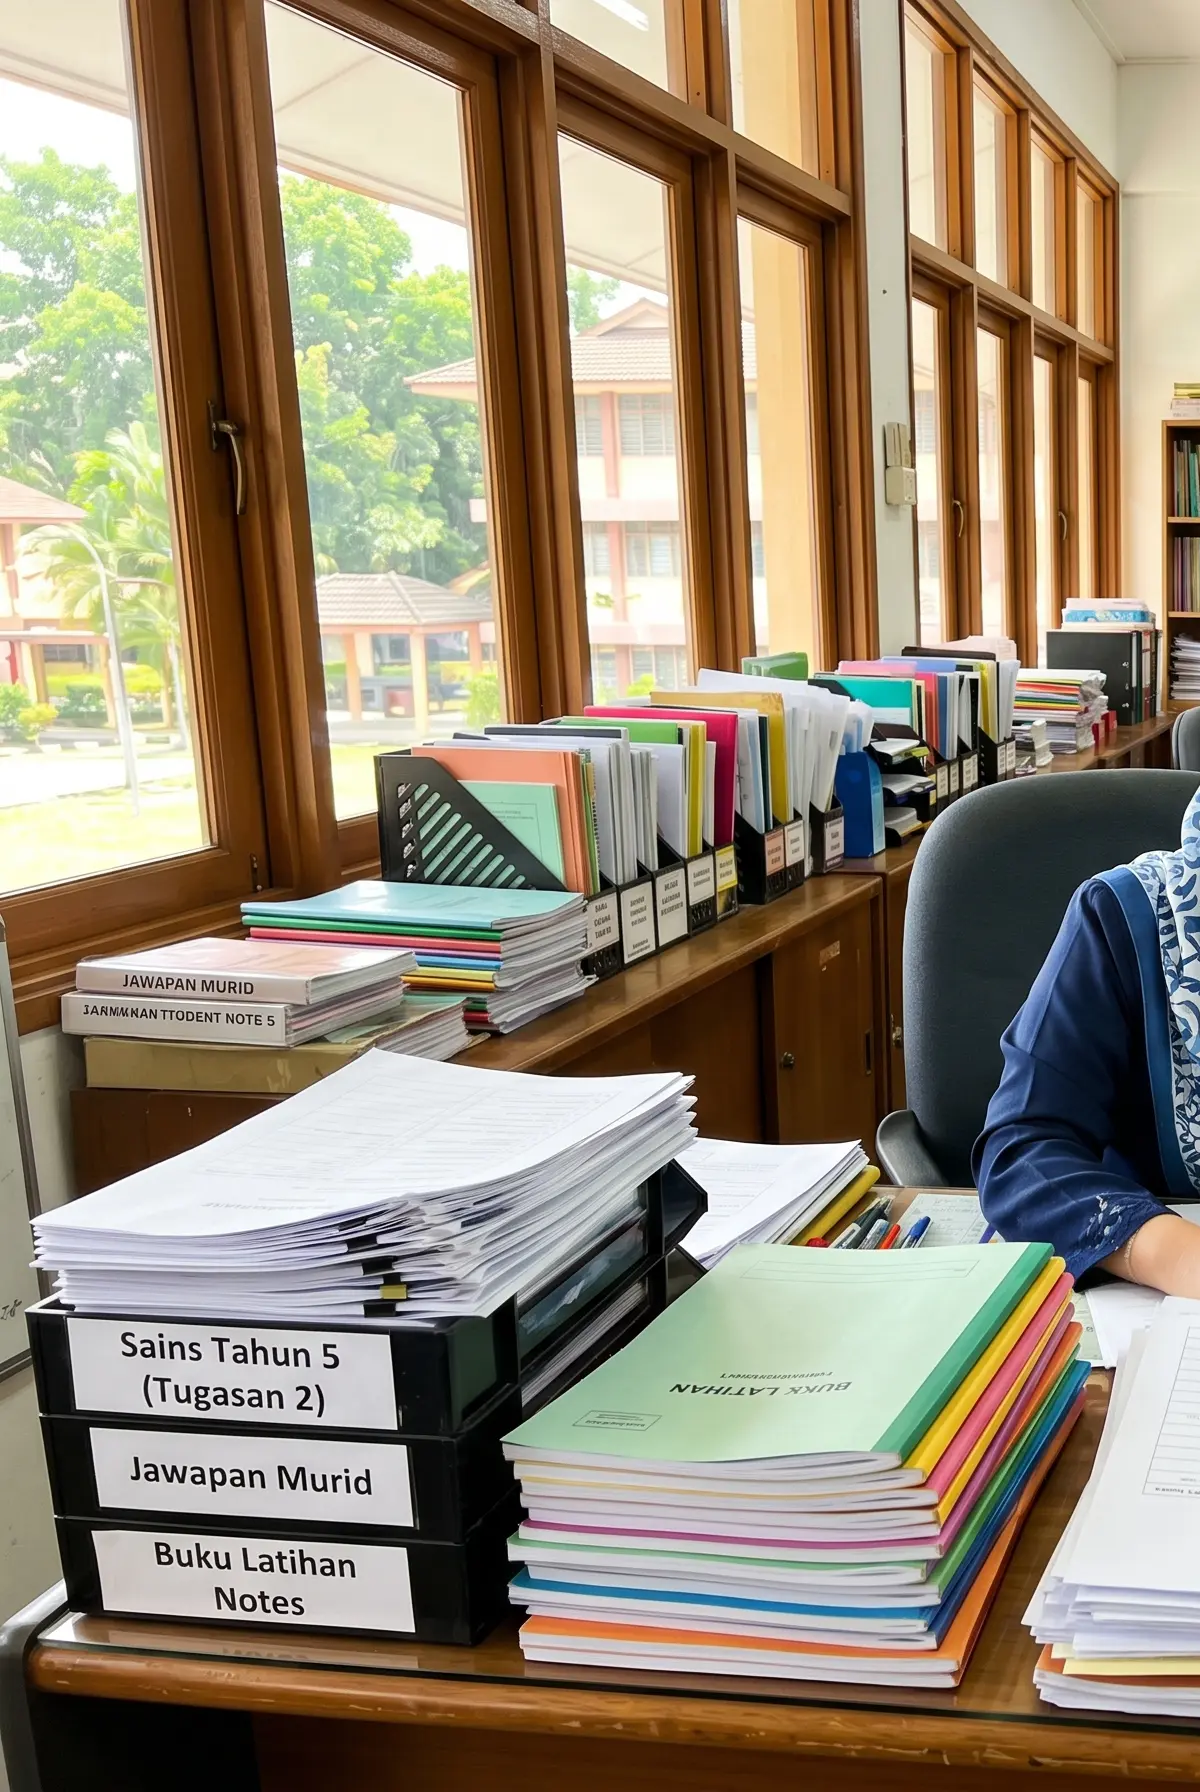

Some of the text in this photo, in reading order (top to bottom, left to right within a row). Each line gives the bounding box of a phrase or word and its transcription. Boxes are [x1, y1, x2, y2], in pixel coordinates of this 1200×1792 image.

[122, 973, 255, 995] JAWAPAN MURID
[225, 1012, 264, 1026] NOTE
[266, 1014, 276, 1027] 5
[120, 1331, 340, 1370] Sains Tahun 5
[142, 1374, 326, 1418] (Tugasan 2)
[668, 1382, 780, 1397] LATIHAN
[130, 1456, 373, 1496] Jawapan Murid
[154, 1541, 357, 1579] Buku Latihan
[214, 1586, 306, 1616] Notes
